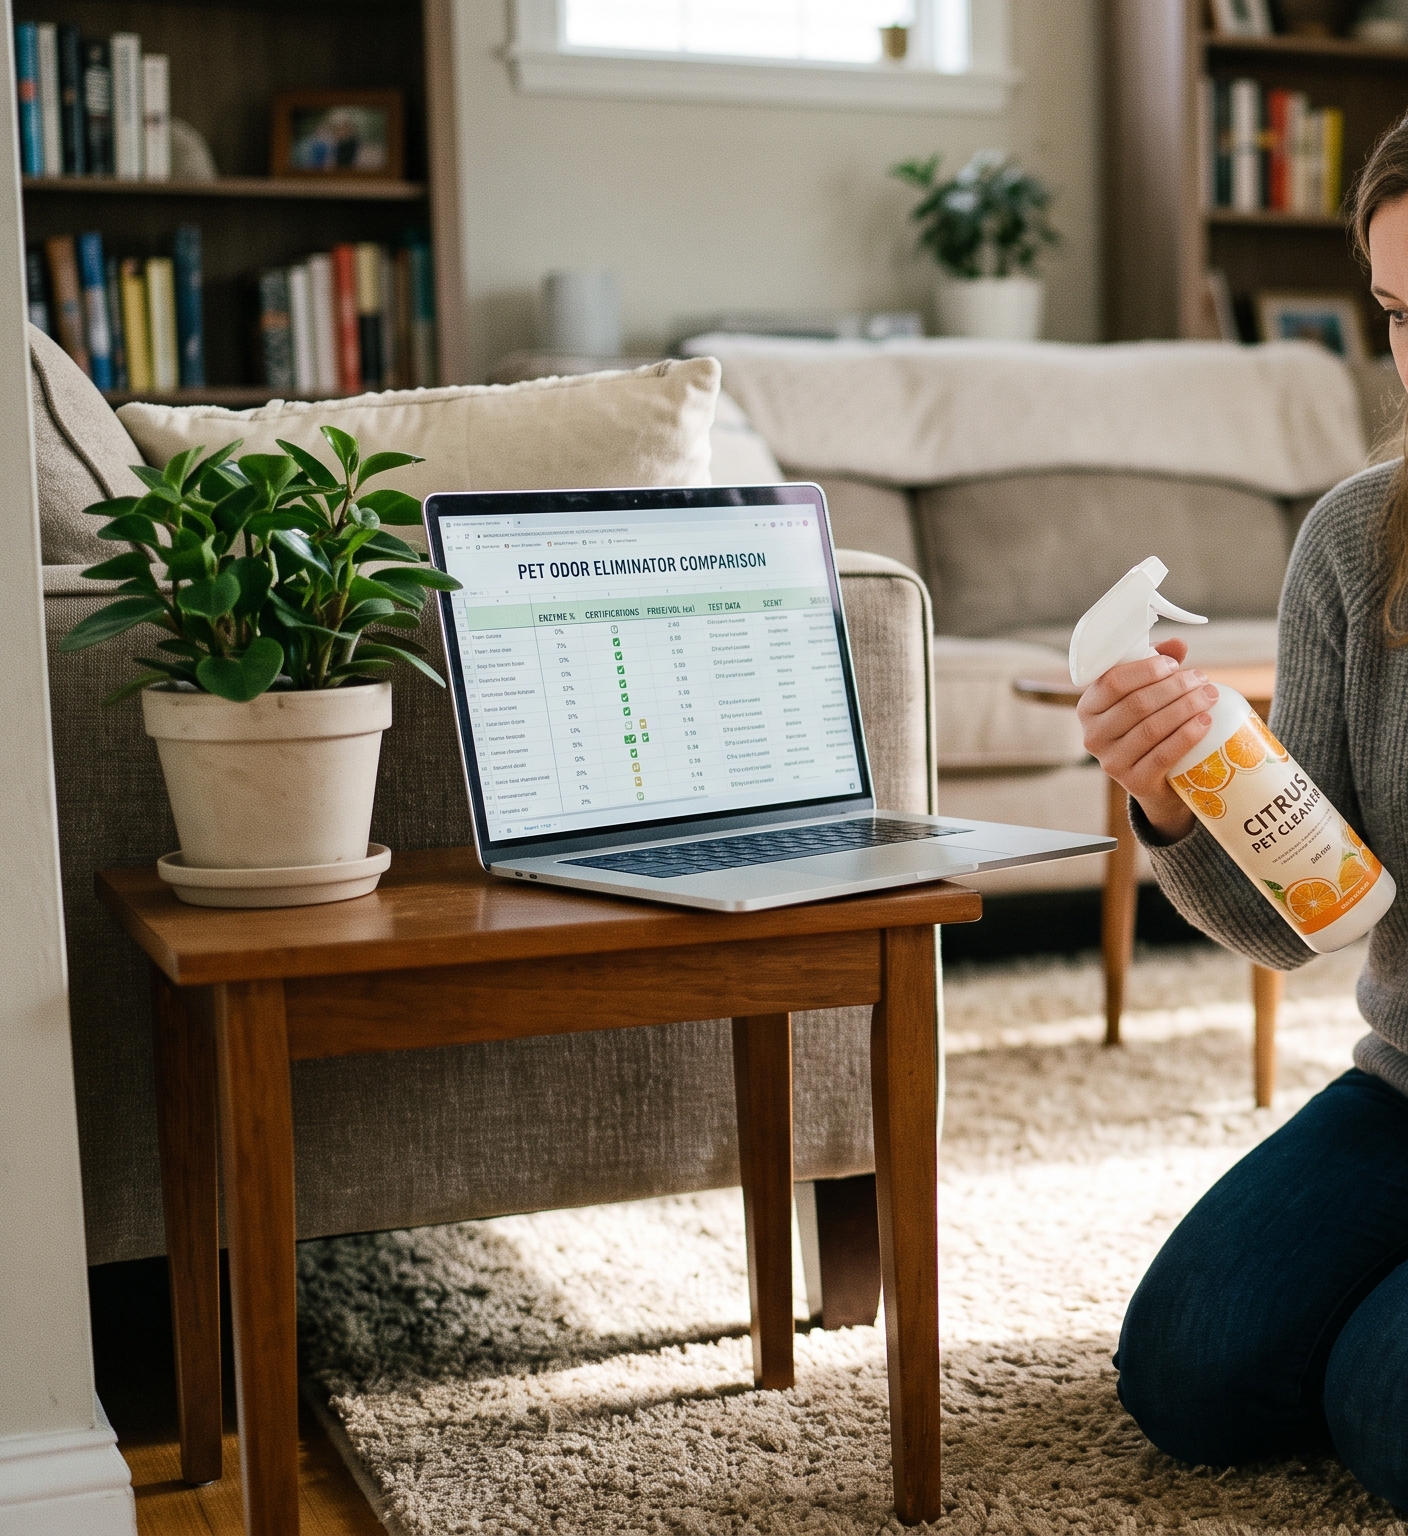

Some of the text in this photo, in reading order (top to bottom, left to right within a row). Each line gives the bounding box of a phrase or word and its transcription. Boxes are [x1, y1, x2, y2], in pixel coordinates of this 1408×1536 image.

[517, 552, 767, 580] PET ODOR ELIMINATOR COMPARISON
[708, 603, 724, 611] TEST
[725, 602, 741, 610] DATA
[763, 599, 783, 607] SCENT
[1243, 772, 1308, 836] CITRUS
[1251, 832, 1278, 854] PET
